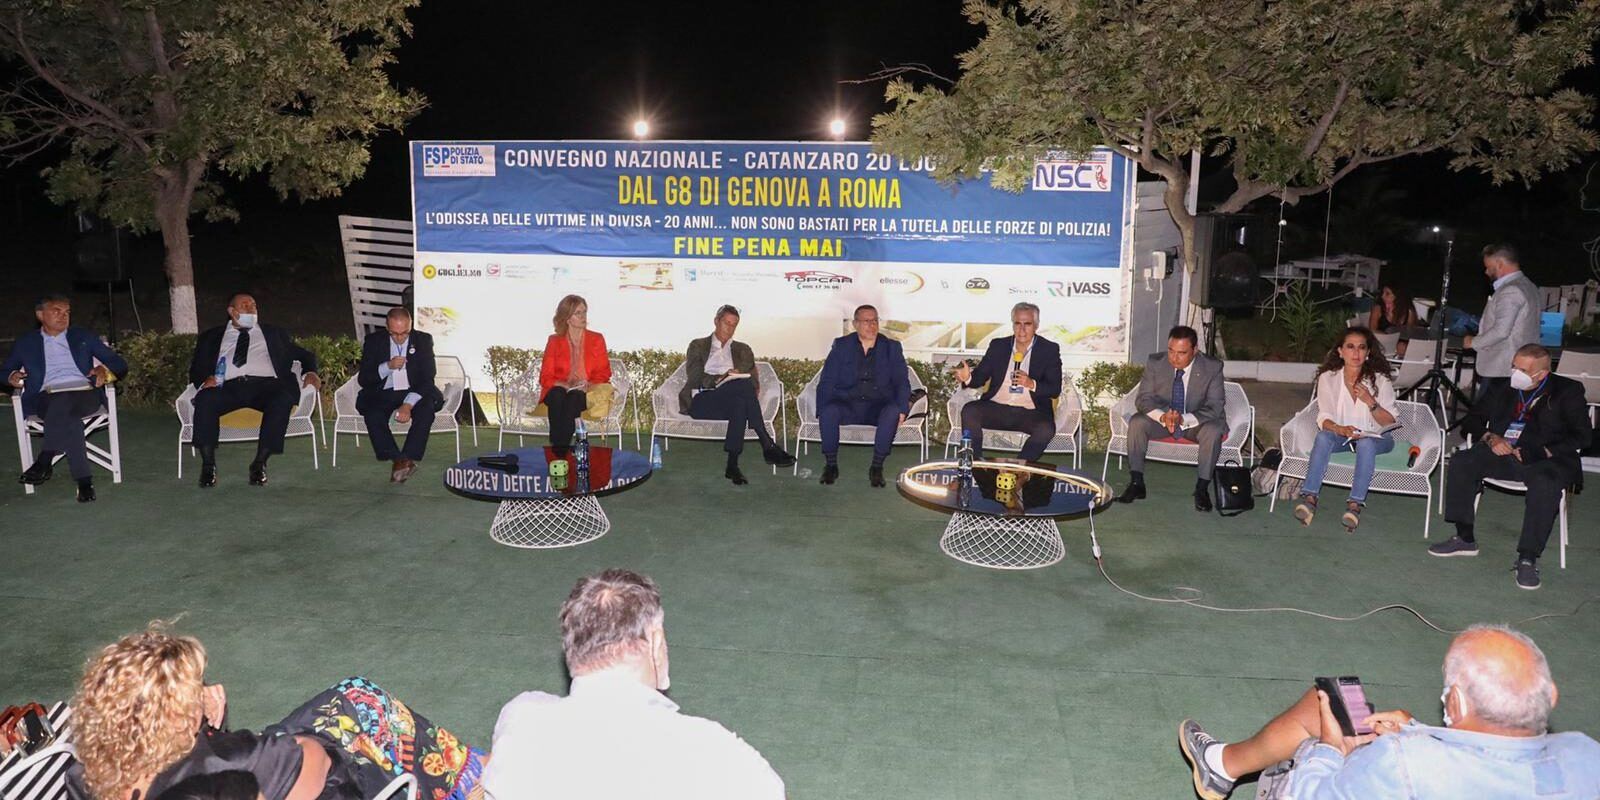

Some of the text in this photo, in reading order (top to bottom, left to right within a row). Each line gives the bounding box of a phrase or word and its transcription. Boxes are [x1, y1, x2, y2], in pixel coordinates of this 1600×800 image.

[425, 147, 450, 164] FSP
[450, 147, 480, 156] POLIZIA
[450, 156, 484, 165] DI STATO
[504, 149, 607, 168] CONVEGNO
[614, 151, 723, 170] NAZIONALE
[744, 152, 859, 171] CATANZARO
[866, 152, 891, 171] 20
[1035, 164, 1092, 188] NSC
[618, 175, 902, 209] DAL G8 DI GENOVA A ROMA
[492, 213, 532, 226] DELLE
[535, 213, 587, 227] VITTIME
[590, 214, 605, 227] IN
[608, 215, 652, 228] DIVISA
[664, 215, 680, 228] 20
[683, 215, 727, 229] ANNI...
[731, 216, 757, 230] NON
[761, 217, 795, 230] SONO
[799, 217, 849, 231] BASTATI
[853, 218, 877, 232] PER
[881, 219, 897, 232] LA
[901, 219, 949, 233] TUTELA
[952, 219, 992, 234] DELLE
[995, 220, 1036, 235] FORZE
[1039, 221, 1053, 236] DI
[1056, 222, 1111, 237] POLIZIA!
[673, 237, 843, 257] FINE PENA MAI
[785, 276, 853, 284] TOPCAR
